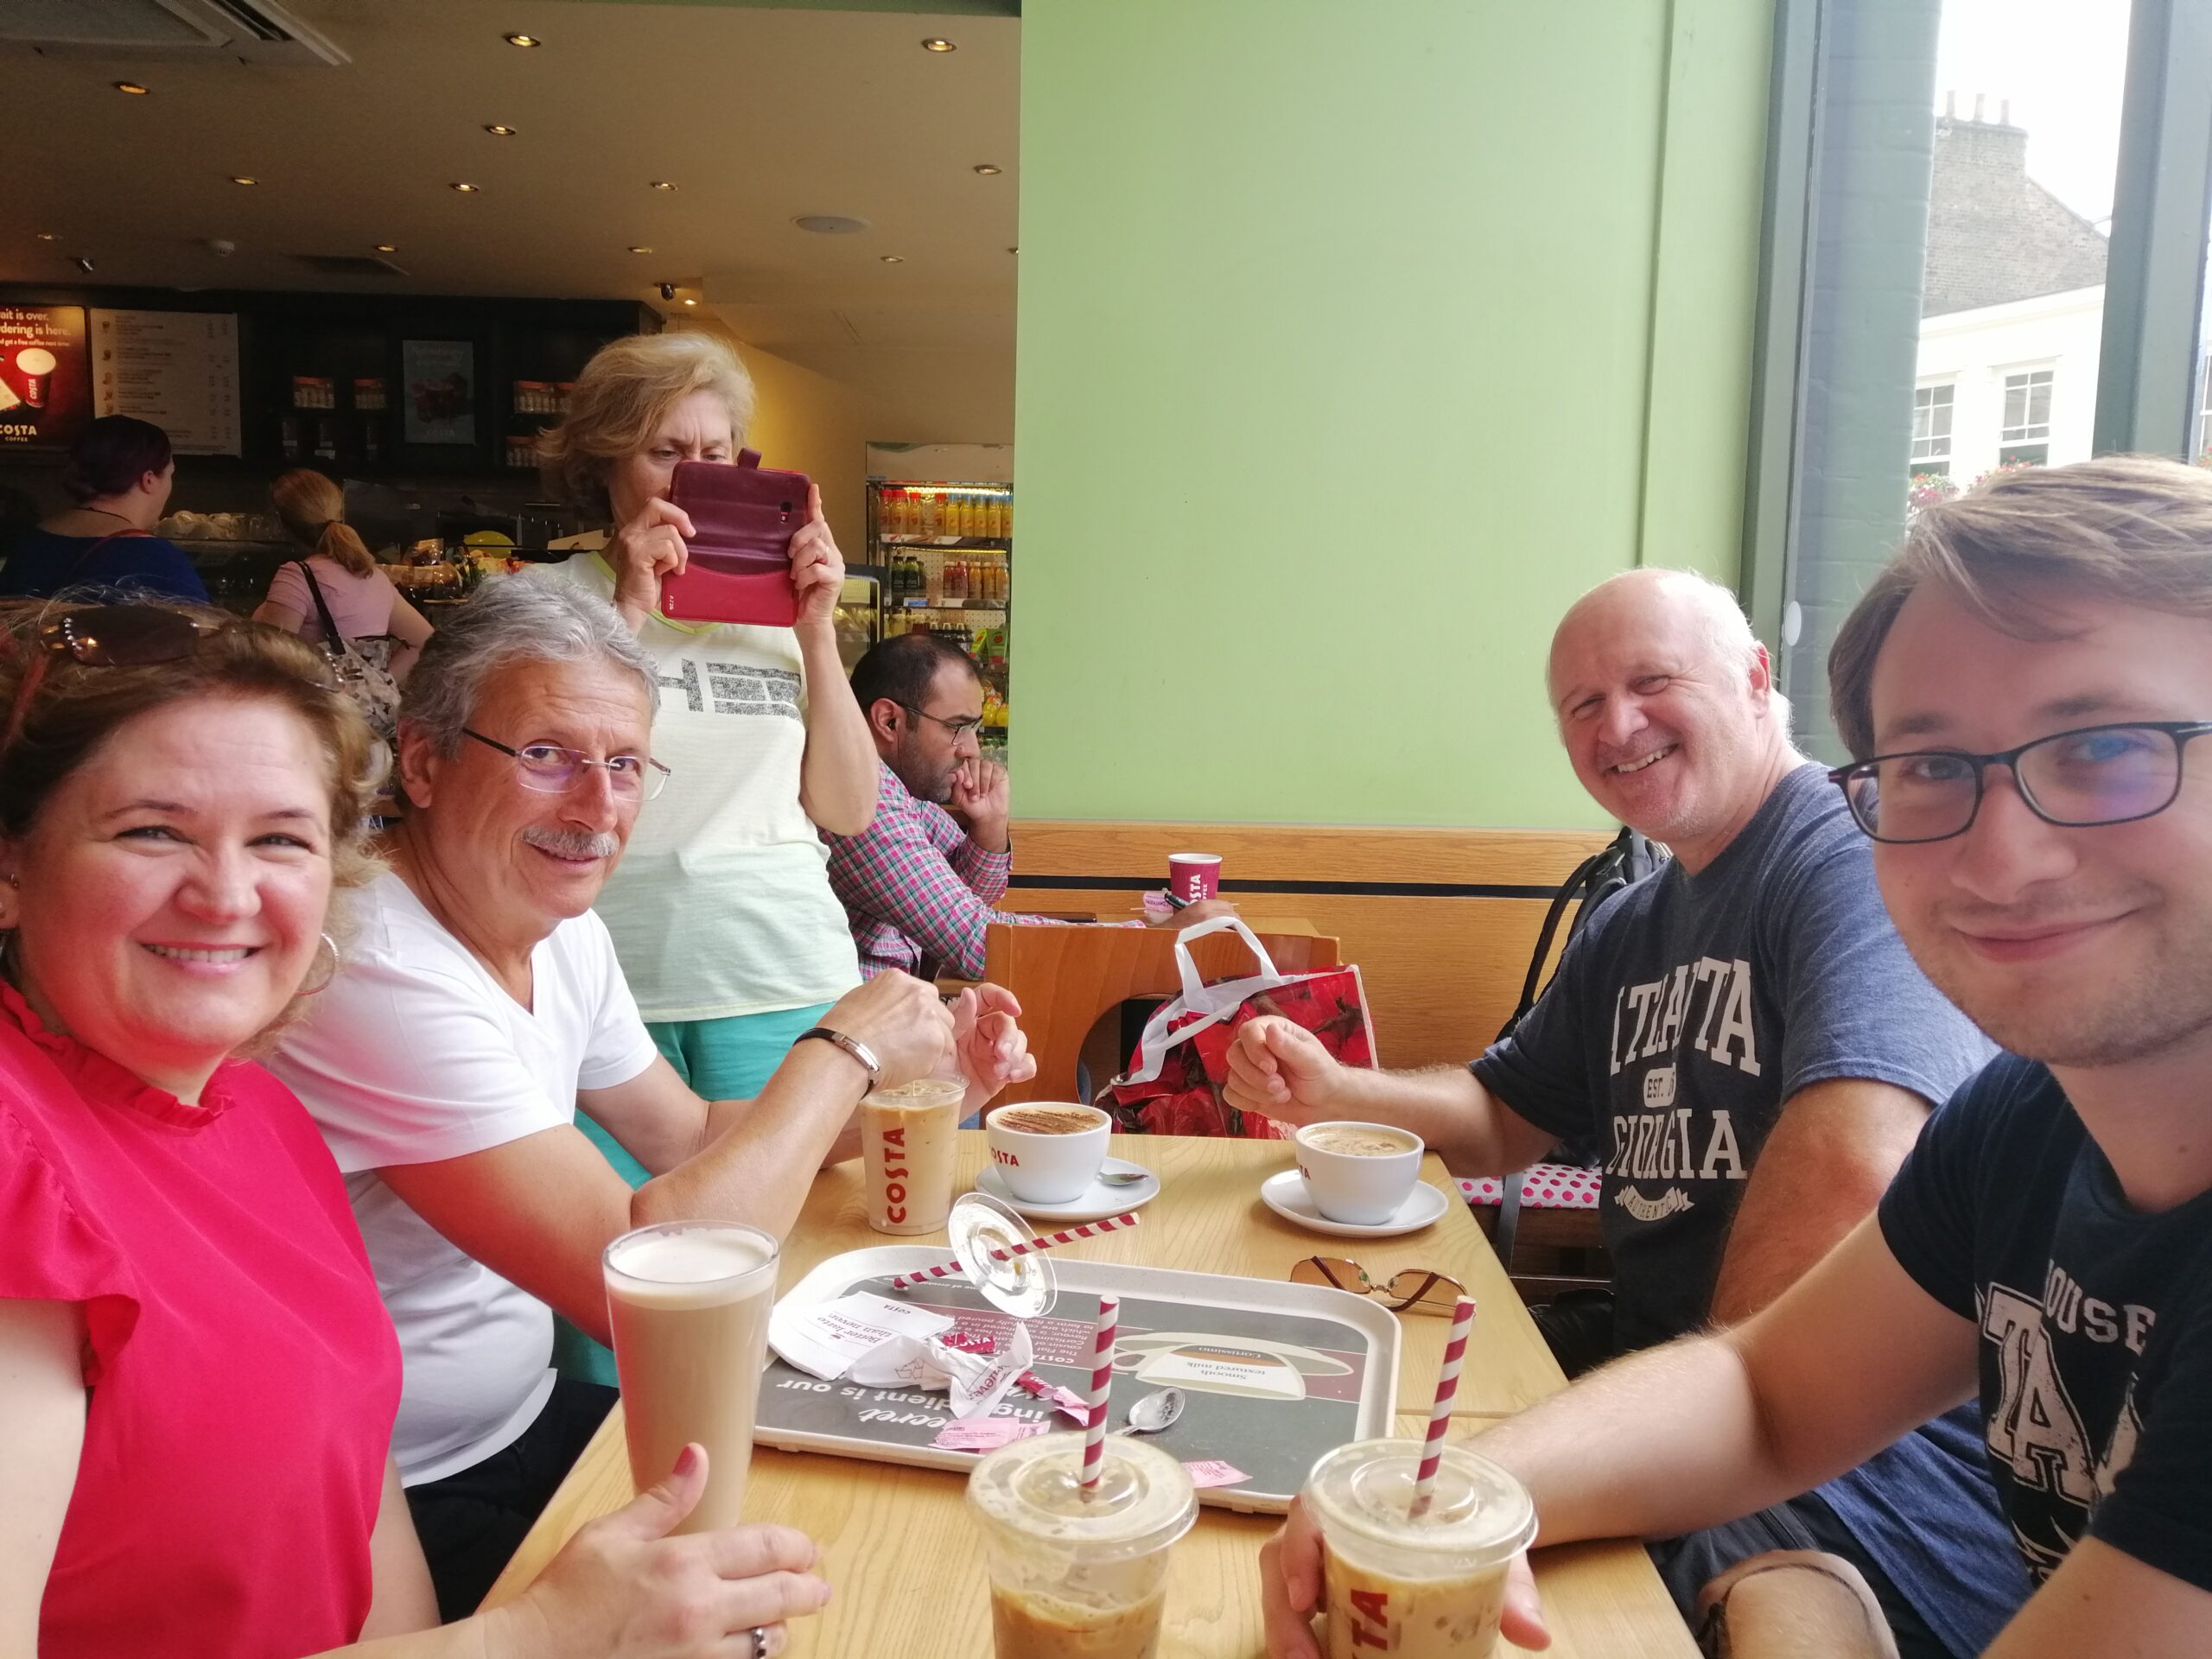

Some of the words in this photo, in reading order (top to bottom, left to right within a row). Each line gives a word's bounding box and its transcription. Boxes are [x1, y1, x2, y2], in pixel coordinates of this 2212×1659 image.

[0, 308, 13, 320] ait
[16, 308, 24, 320] is
[26, 312, 48, 321] over.
[0, 321, 34, 338] dering
[35, 323, 43, 334] is
[46, 324, 71, 335] here.
[29, 378, 37, 400] COSTA
[1647, 1078, 1663, 1098] EST.
[988, 1147, 1020, 1167] OSTA
[883, 1128, 908, 1224] COSTA
[883, 1304, 912, 1315] COSTA
[817, 1317, 843, 1335] latte
[961, 1316, 995, 1325] poured
[843, 1330, 882, 1344] Better
[861, 1326, 892, 1338] than
[1052, 1331, 1088, 1340] flavour,
[1198, 1346, 1262, 1359] Cortissimo
[1185, 1362, 1213, 1371] milk
[1215, 1363, 1266, 1376] textured
[1200, 1370, 1249, 1381] Smooth
[776, 1380, 831, 1392] our
[840, 1387, 867, 1400] is
[858, 1409, 947, 1429] ecret
